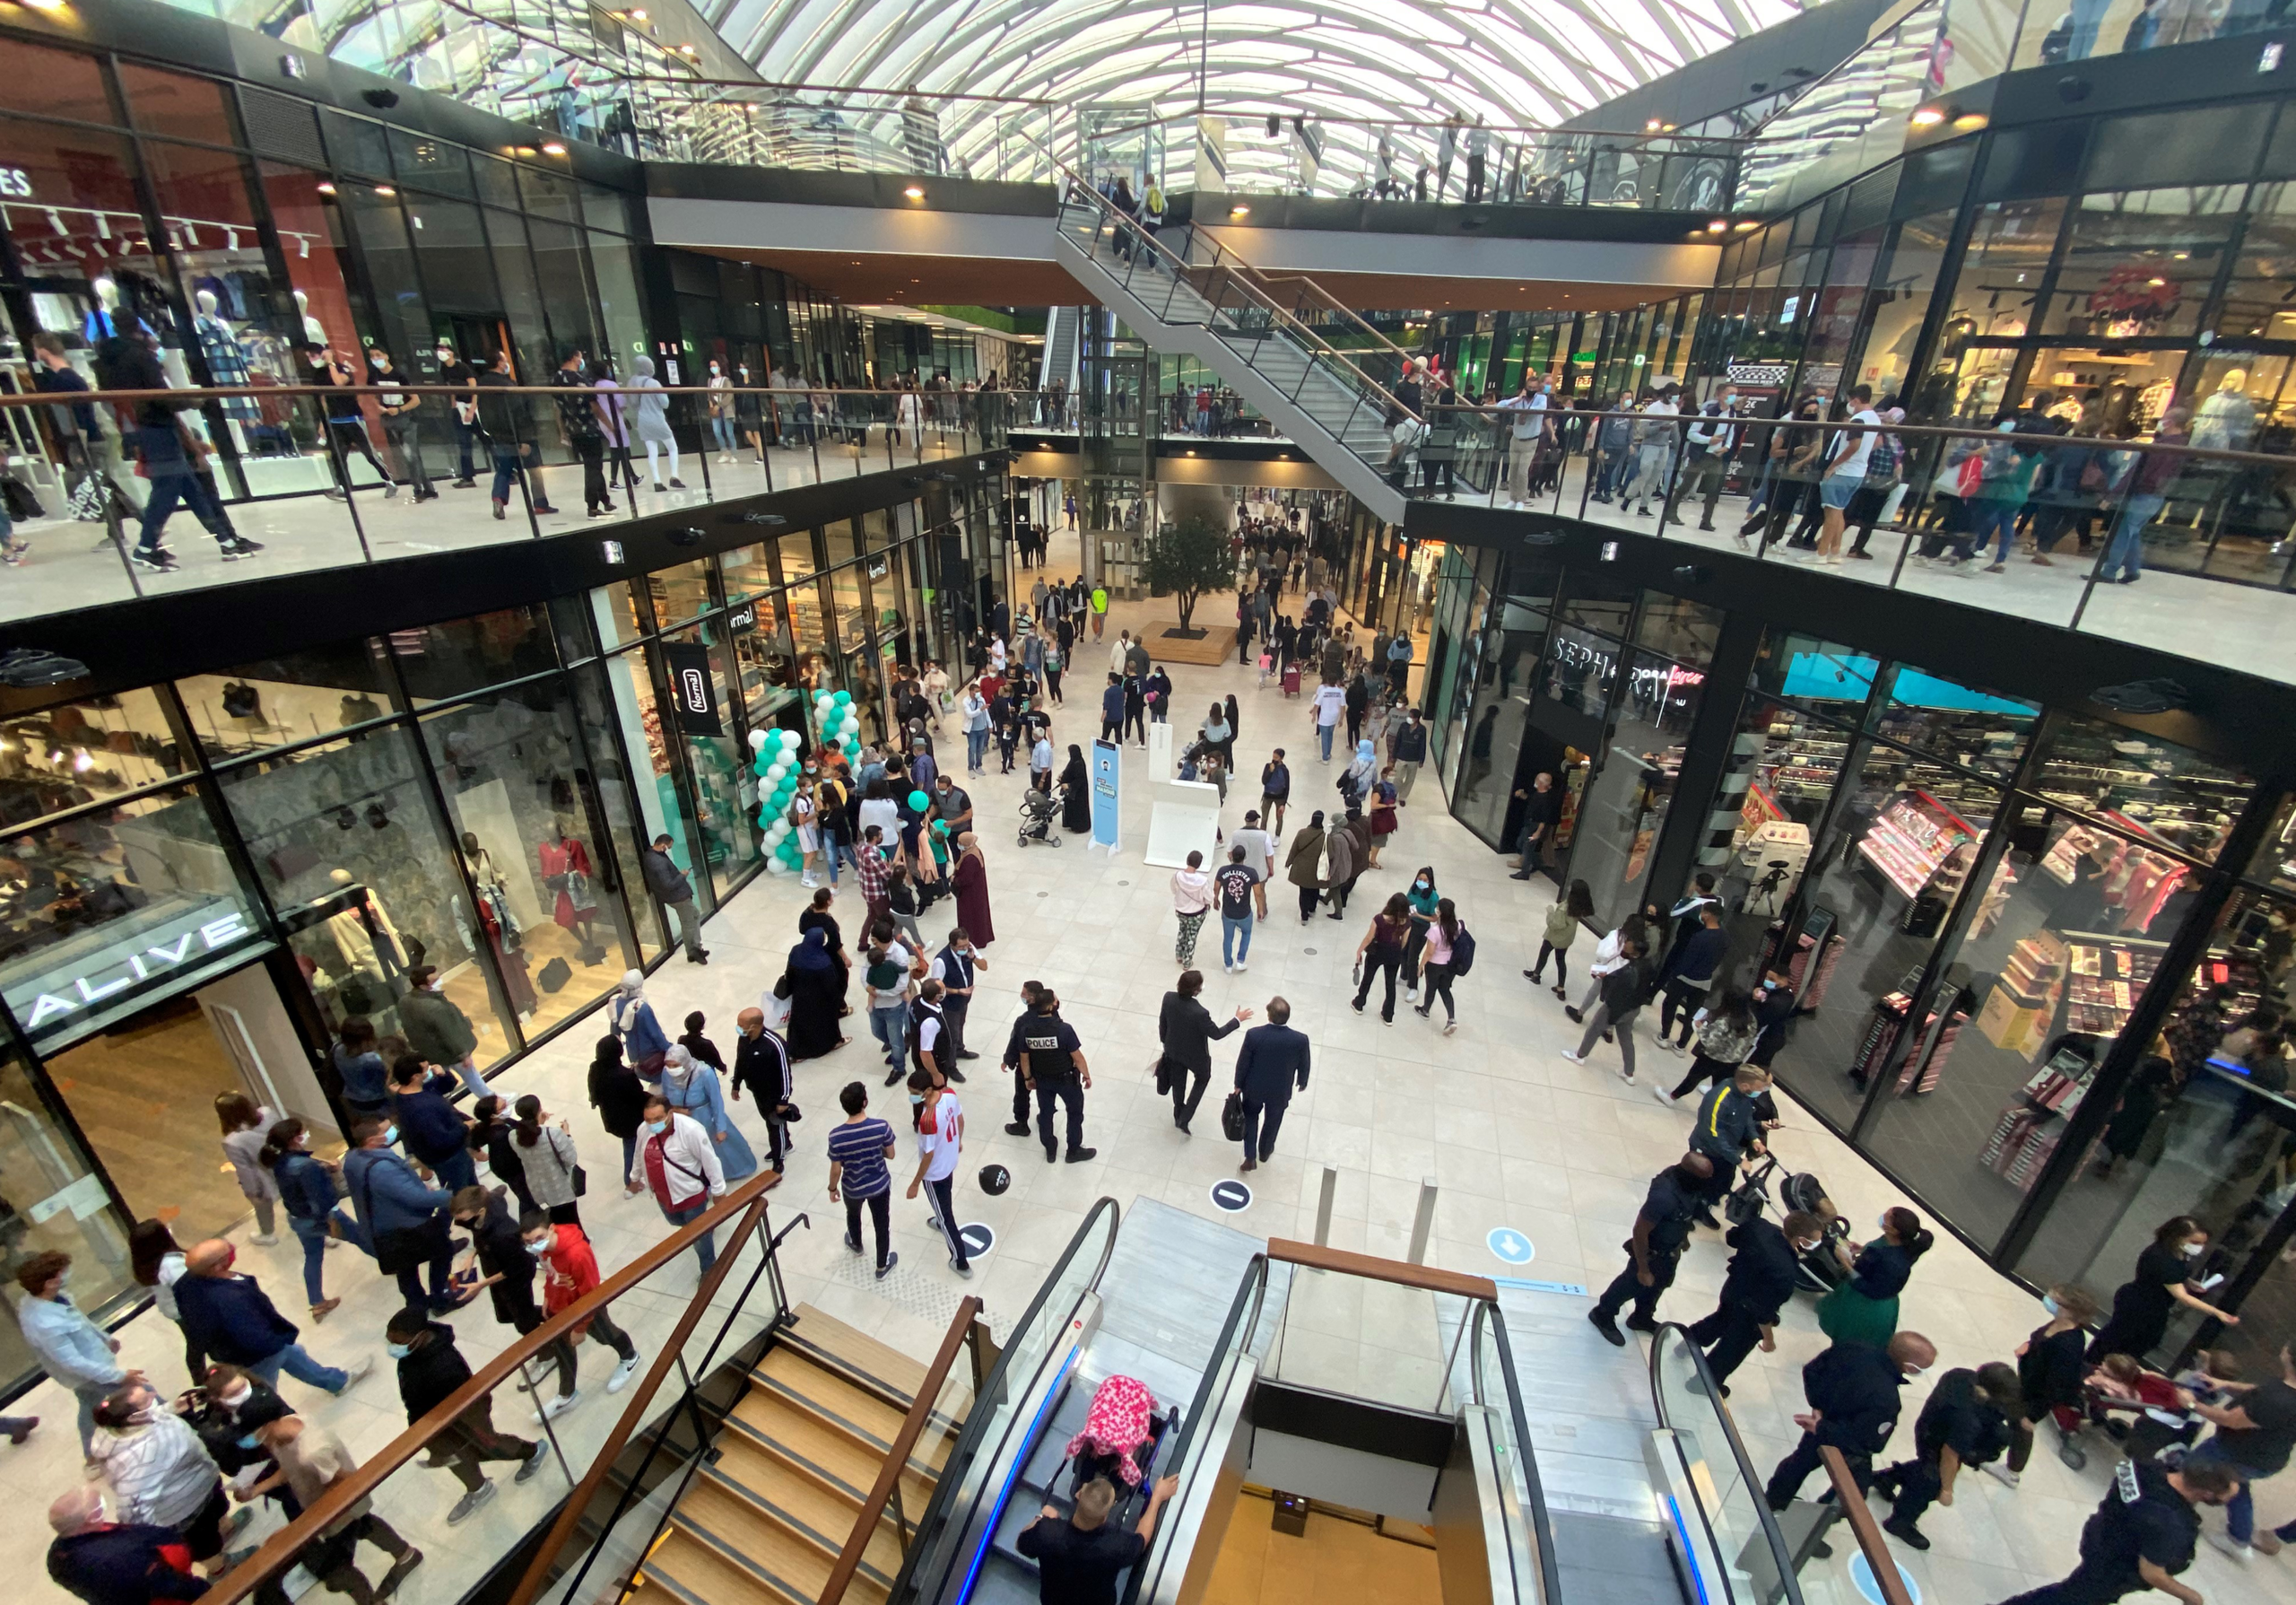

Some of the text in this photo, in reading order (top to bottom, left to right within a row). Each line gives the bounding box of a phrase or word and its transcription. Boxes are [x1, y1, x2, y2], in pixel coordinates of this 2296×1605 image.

[686, 673, 704, 708] Normal
[1222, 869, 1251, 883] HOLLISTER
[1027, 1038, 1057, 1048] POLICE
